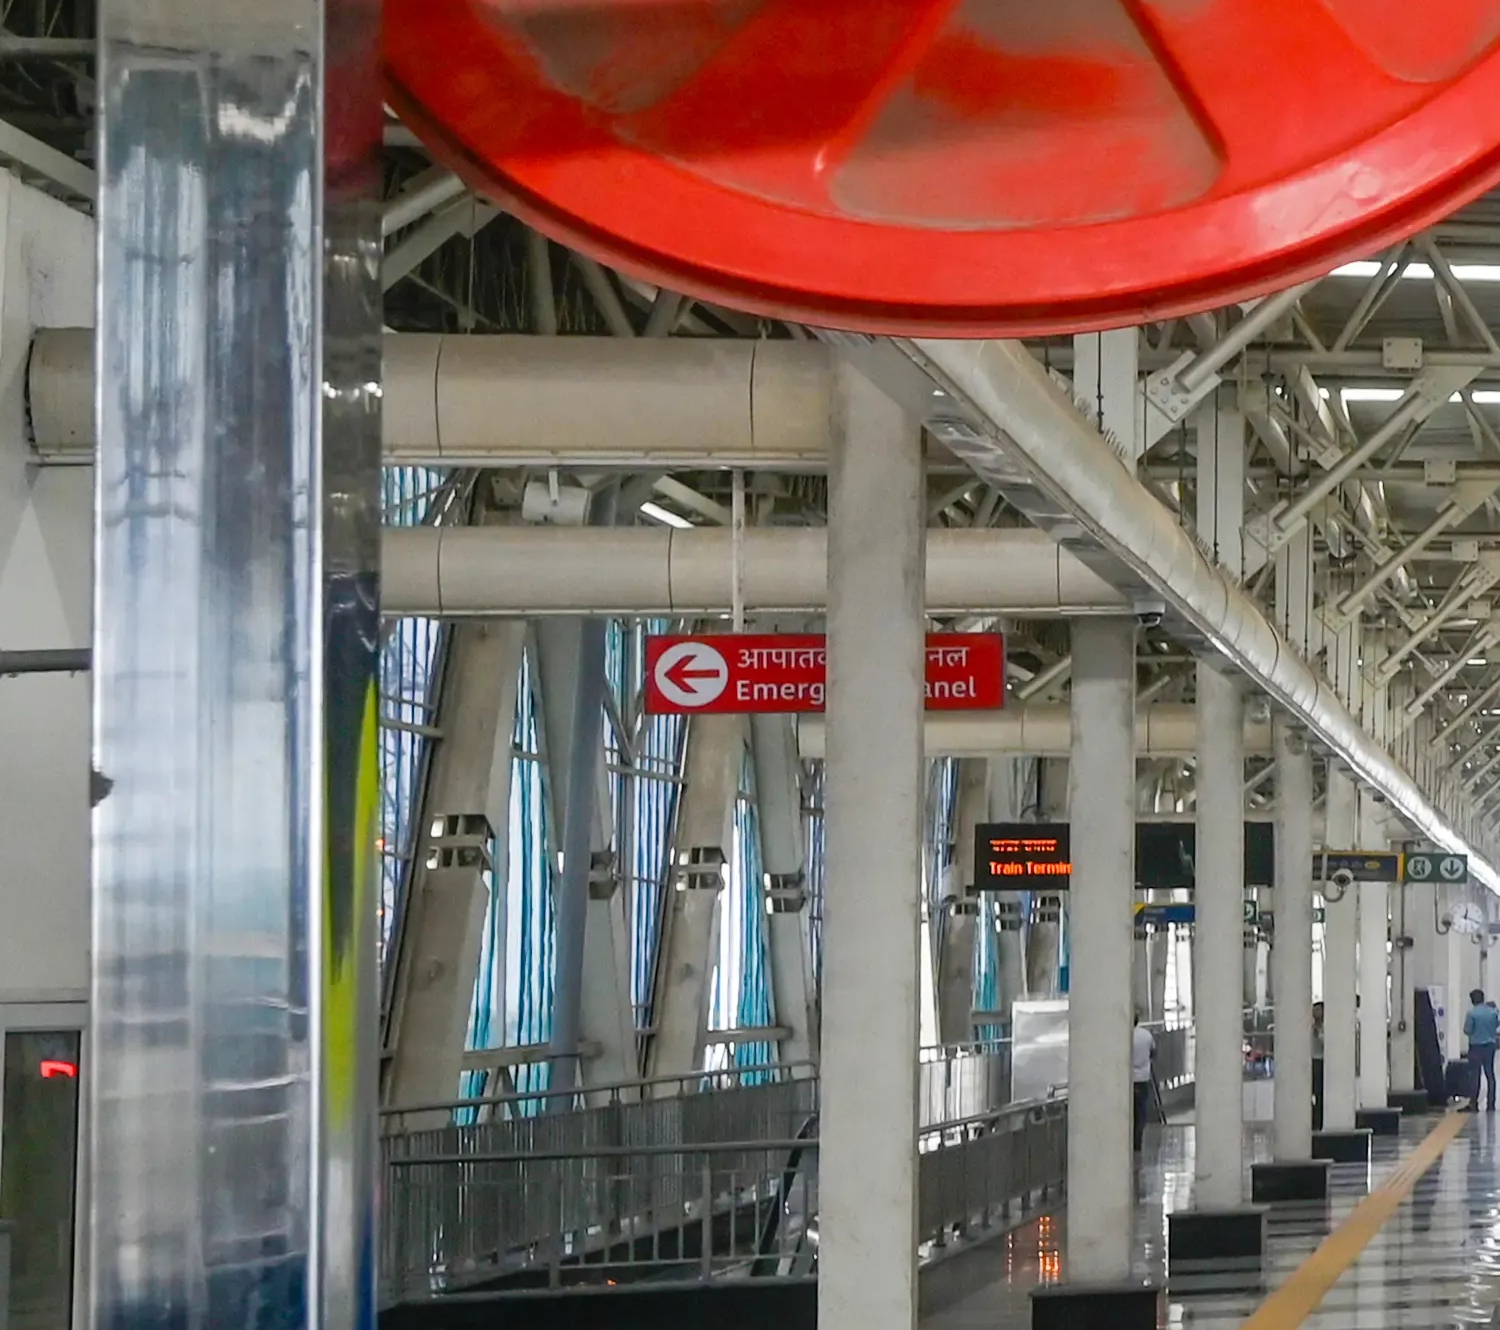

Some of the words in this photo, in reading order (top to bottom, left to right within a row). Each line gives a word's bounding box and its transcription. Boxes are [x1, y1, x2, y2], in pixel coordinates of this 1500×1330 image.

[925, 646, 971, 668] नल
[736, 679, 825, 705] Emerg
[924, 675, 977, 698] anel
[989, 861, 1023, 875] Train
[1025, 861, 1073, 875] Termin
